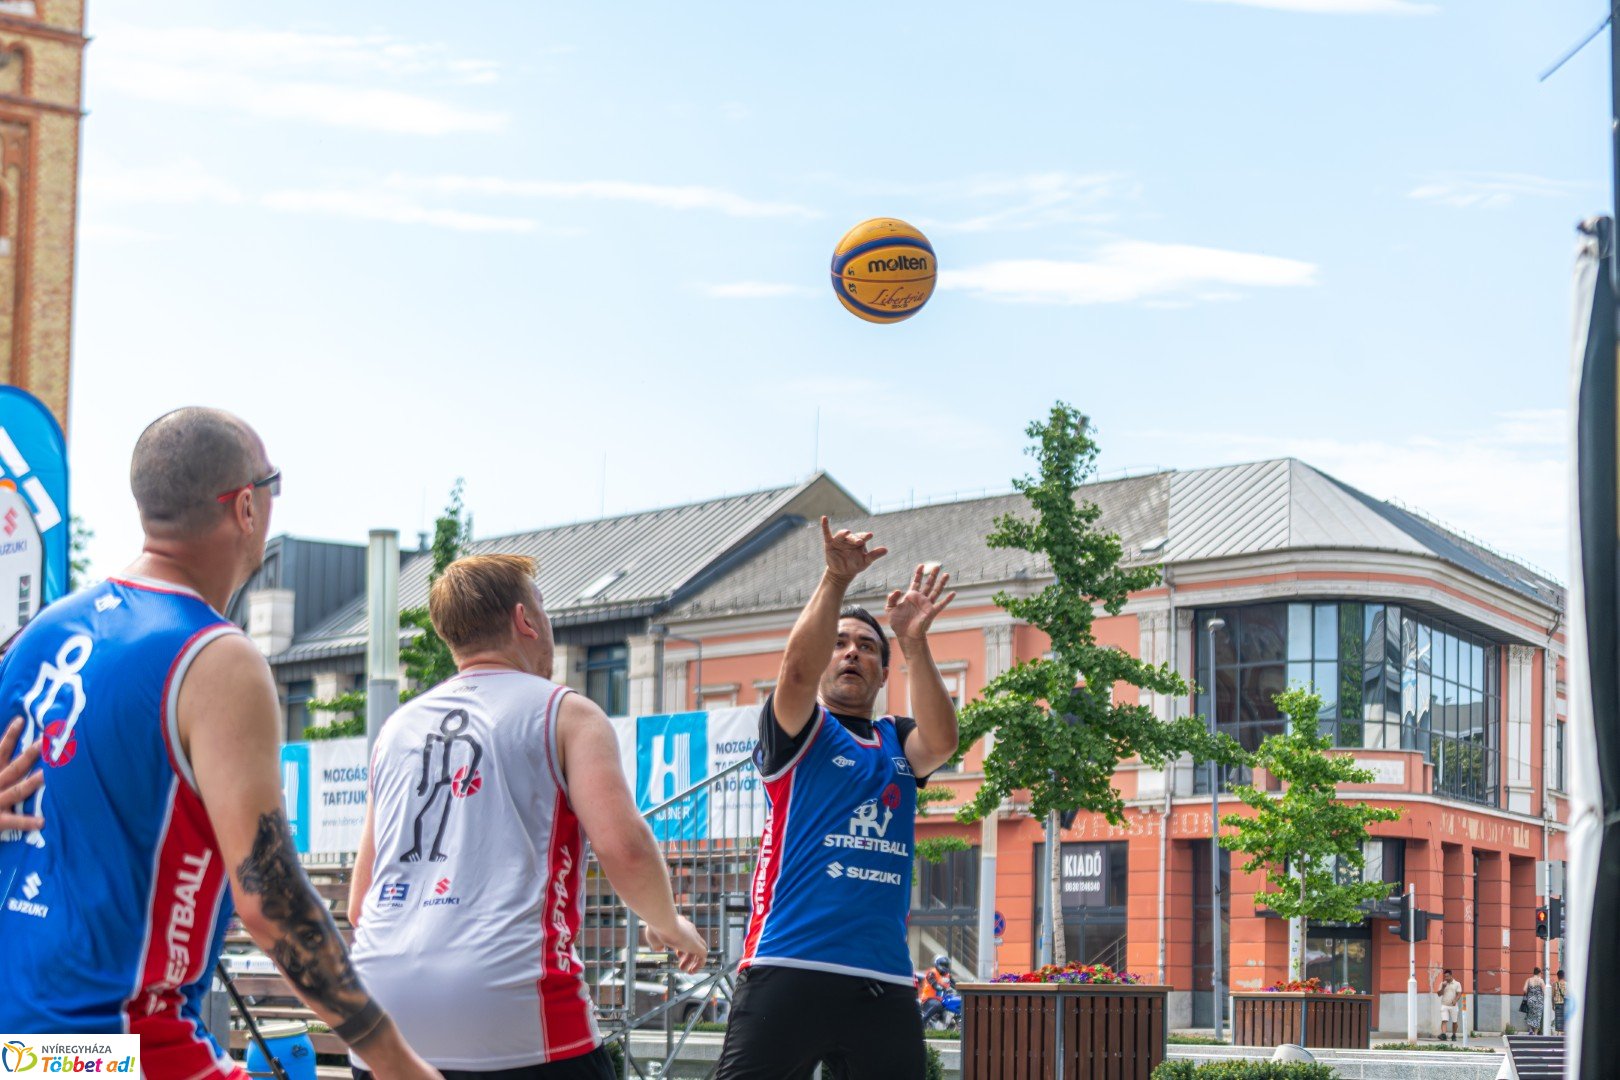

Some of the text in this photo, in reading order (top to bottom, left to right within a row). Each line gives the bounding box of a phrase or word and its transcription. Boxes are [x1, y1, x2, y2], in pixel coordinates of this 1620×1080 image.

[868, 256, 927, 272] molten
[0, 540, 27, 556] UZUKI
[323, 764, 368, 782] MOZGÁS
[823, 834, 909, 857] STREETBALL
[1065, 850, 1102, 877] KIADÓ
[847, 866, 901, 885] SUZUKI
[8, 897, 49, 918] SUZUKI
[423, 897, 460, 907] SUZUKI
